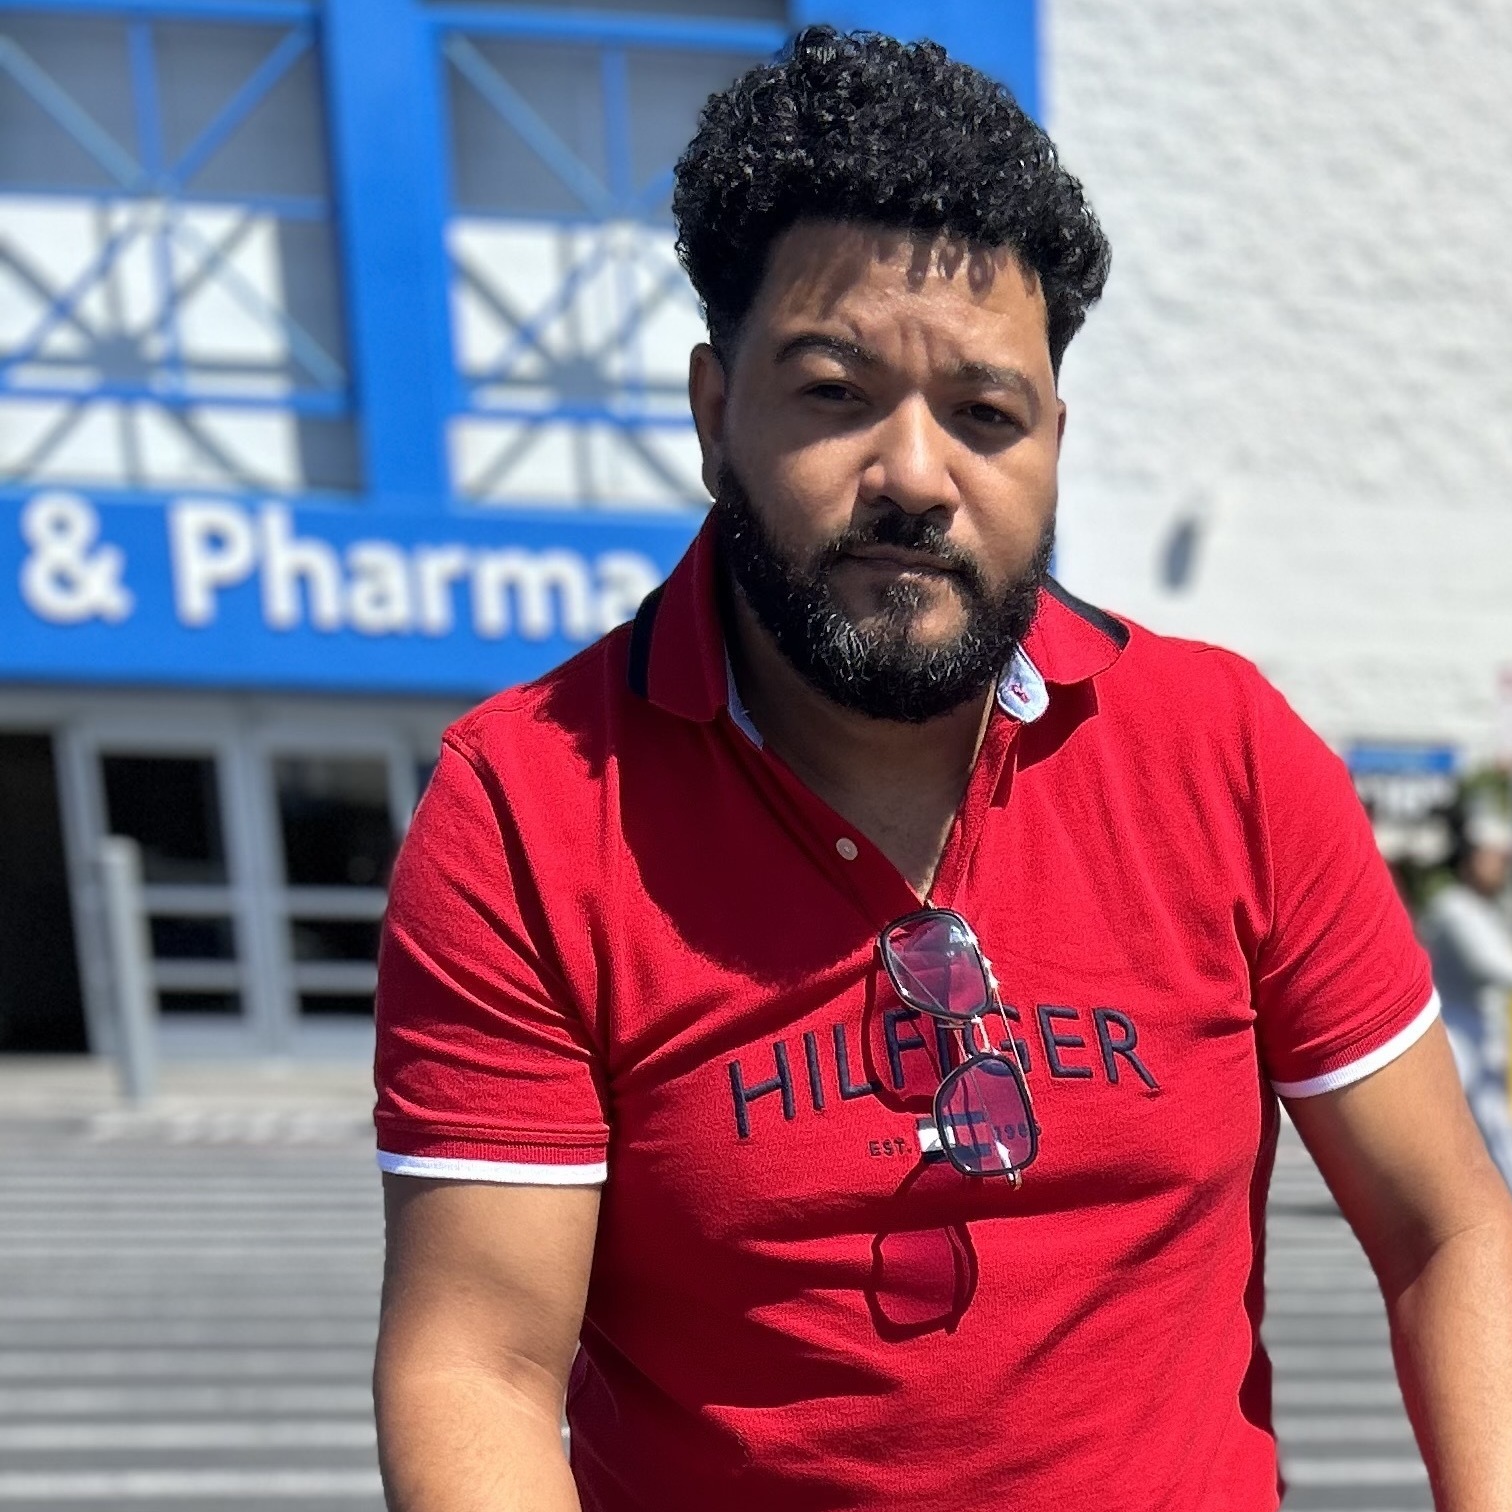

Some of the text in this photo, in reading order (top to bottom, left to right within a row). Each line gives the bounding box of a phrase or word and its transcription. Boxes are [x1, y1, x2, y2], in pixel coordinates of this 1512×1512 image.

[21, 495, 132, 625] &
[728, 1003, 1162, 1140] HILFIGER
[869, 1136, 912, 1157] EST.
